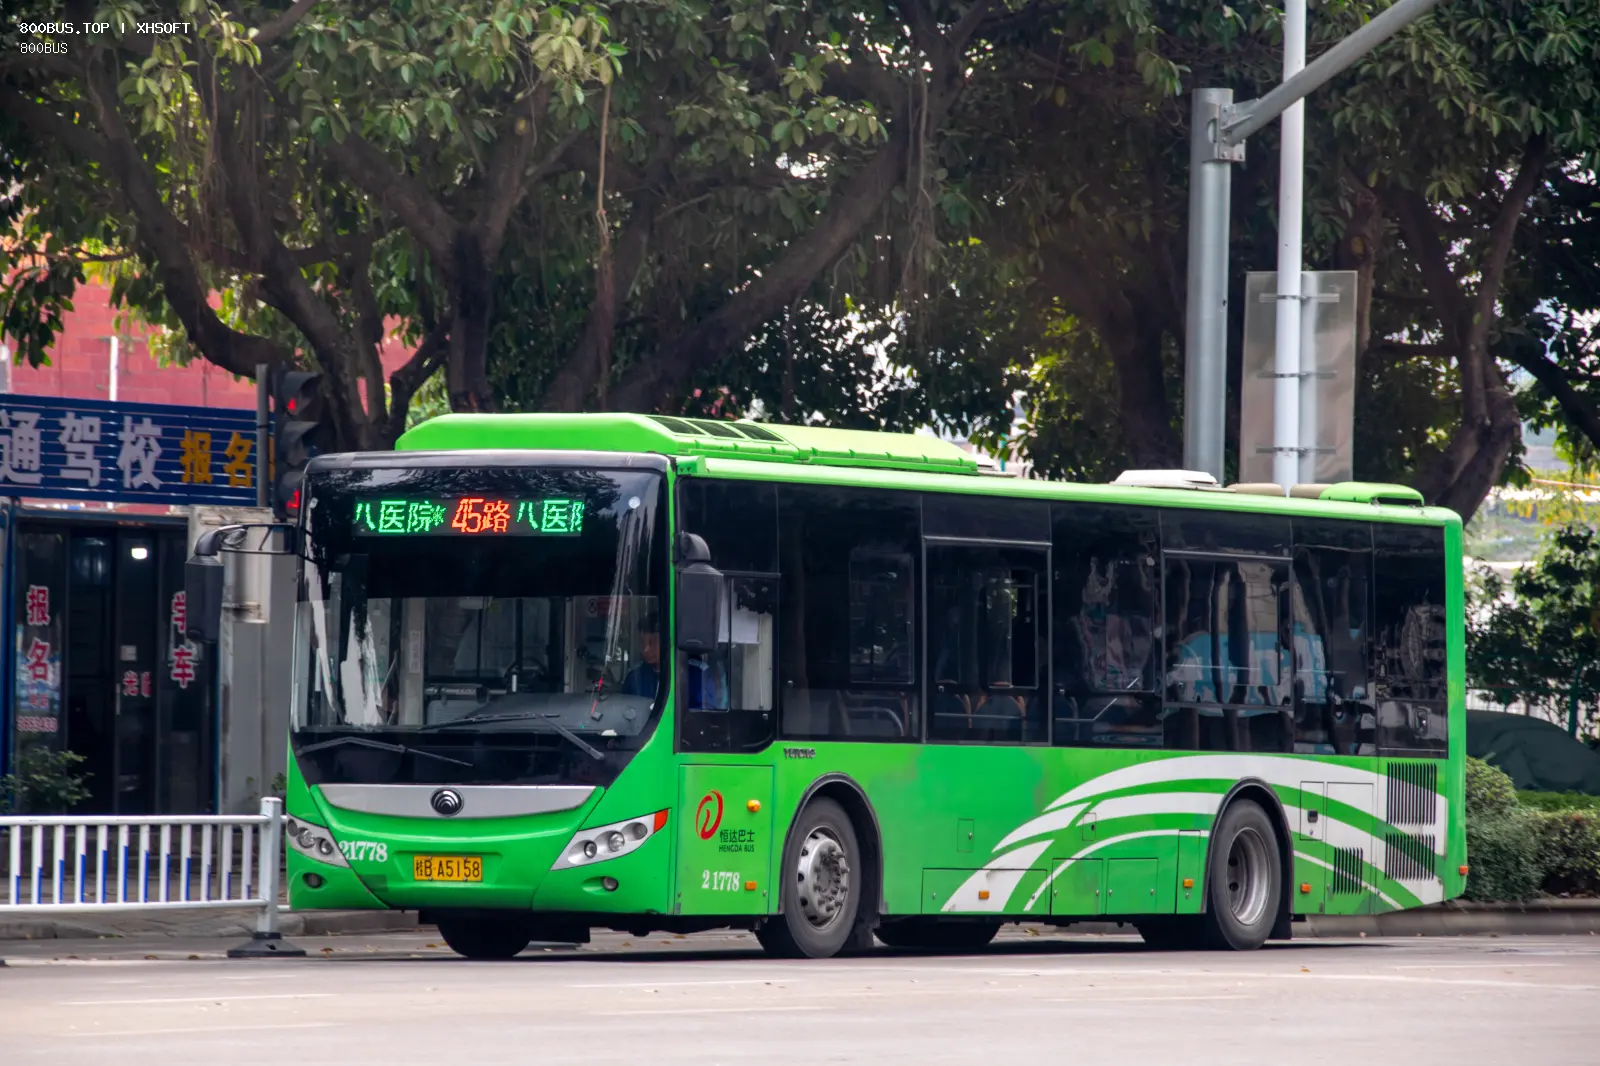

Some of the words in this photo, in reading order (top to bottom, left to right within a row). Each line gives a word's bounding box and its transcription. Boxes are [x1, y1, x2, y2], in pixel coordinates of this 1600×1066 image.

[0, 409, 163, 490] 通驾校
[179, 429, 275, 488] 报名
[355, 499, 431, 533] 八医院
[451, 498, 511, 533] 45路
[27, 585, 51, 684] 报名
[719, 828, 756, 843] 恒达巴士
[339, 840, 388, 863] 21778
[718, 844, 742, 853] HENGDA
[744, 844, 755, 853] BUS
[701, 869, 740, 892] 21778
